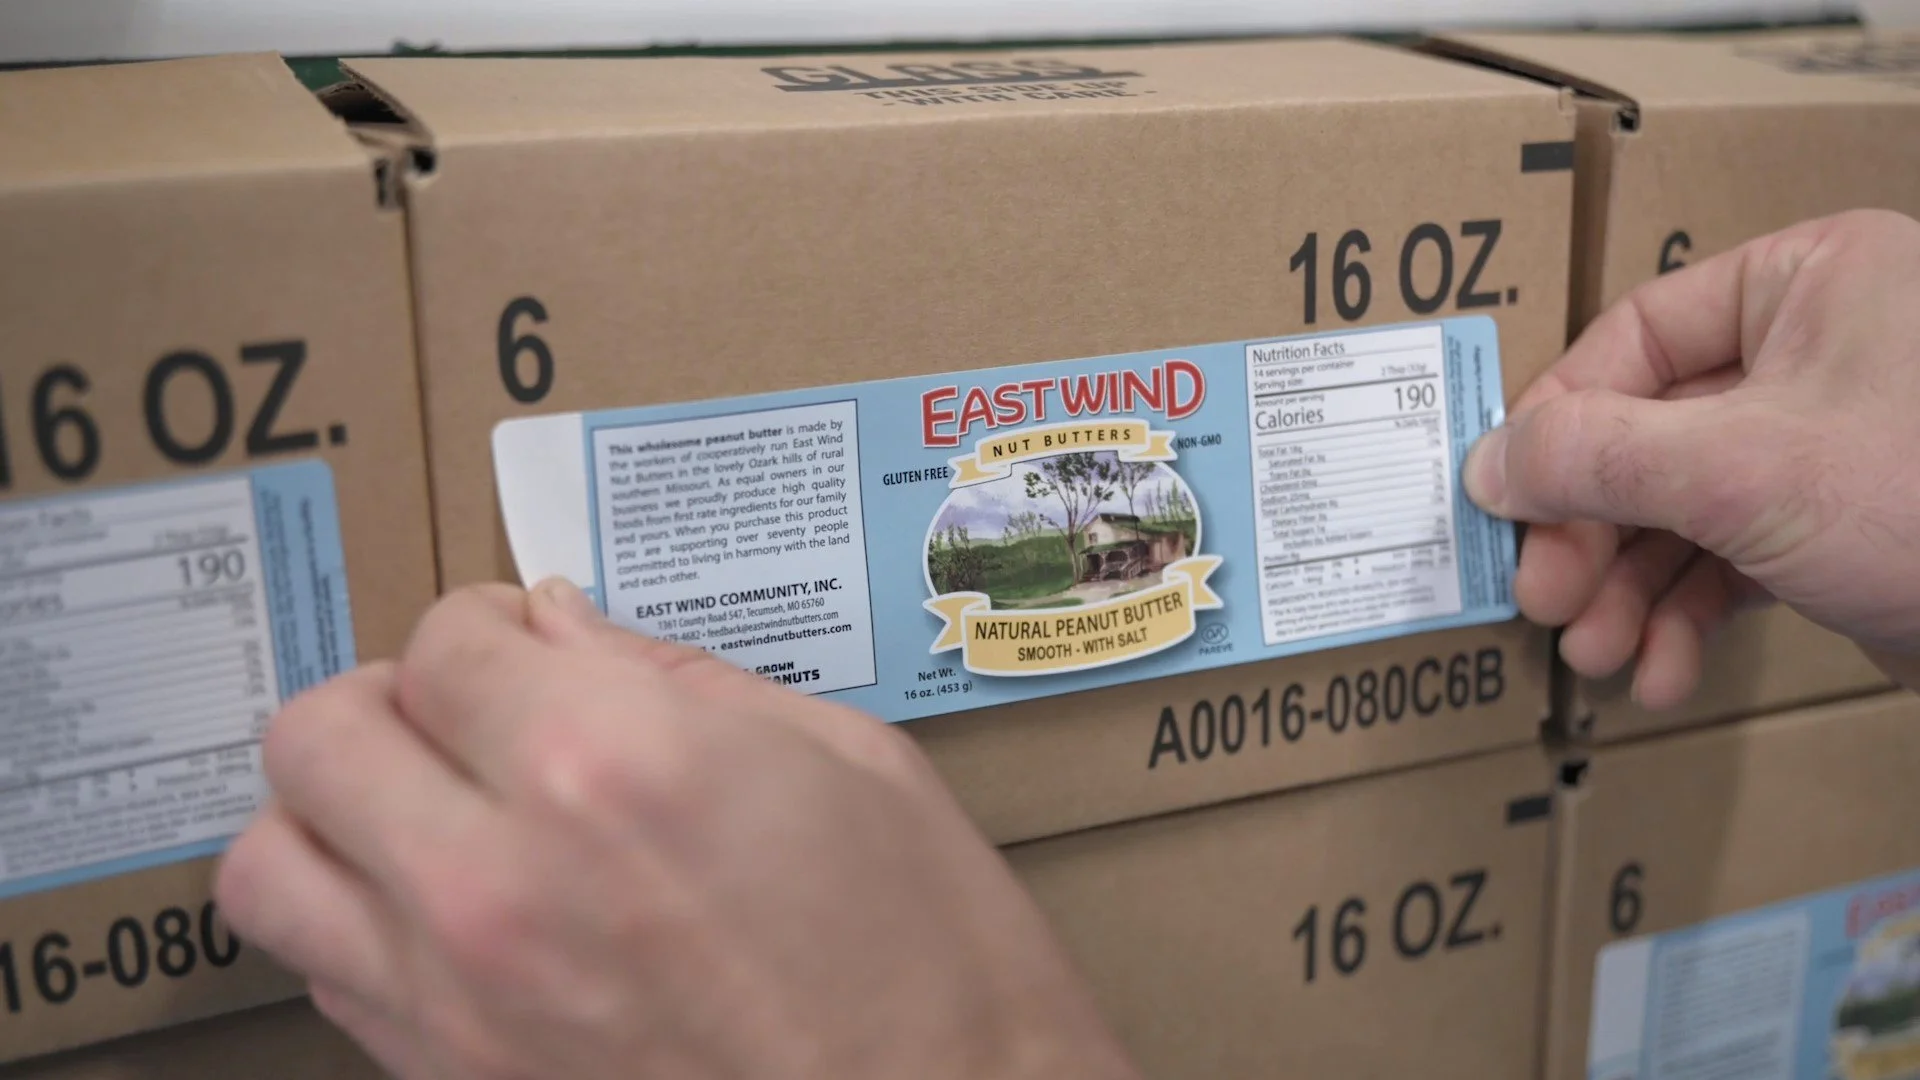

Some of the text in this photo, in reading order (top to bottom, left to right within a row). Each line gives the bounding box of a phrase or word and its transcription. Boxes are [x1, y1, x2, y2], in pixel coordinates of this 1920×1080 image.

[760, 60, 1103, 90] GLASS
[854, 81, 1127, 99] THIS SIDE UP
[897, 90, 1138, 105] WITH CARE
[1290, 220, 1518, 324] 16 OZ.
[498, 297, 554, 403] 6
[1253, 342, 1345, 363] Nutrition Facts
[1254, 361, 1354, 378] 14 servings per container
[1254, 380, 1286, 391] Serving
[143, 340, 346, 467] OZ.
[920, 359, 1206, 448] EAST WIND
[1255, 382, 1436, 430] Calories 190
[609, 419, 843, 456] This wholesome peanut butter is made by
[609, 433, 843, 471] the workers of cooperatively run East Wind
[992, 429, 1132, 457] NUT BUTTERS
[1177, 434, 1222, 450] NON-GMO
[636, 471, 673, 483] Butters
[678, 468, 688, 477] in
[692, 465, 710, 476] the
[714, 460, 744, 473] lovely
[749, 456, 778, 469] Ozark
[782, 453, 802, 464] hills
[806, 450, 817, 461] of
[821, 447, 844, 460] rural
[718, 477, 730, 487] As
[736, 471, 764, 486] equal
[770, 468, 807, 480] owners
[812, 464, 822, 475] in
[827, 463, 845, 474] our
[883, 467, 948, 486] GLUTEN FREE
[664, 500, 681, 509] we
[686, 491, 728, 509] proudly
[734, 486, 776, 502] produce
[782, 482, 805, 495] high
[811, 477, 846, 491] quality
[673, 511, 694, 522] first
[696, 509, 717, 519] rate
[719, 501, 777, 518] ingredients
[780, 498, 794, 508] for
[796, 496, 814, 506] our
[816, 491, 847, 503] family
[614, 532, 635, 545] and
[675, 525, 706, 537] When
[709, 522, 730, 535] you
[734, 515, 781, 531] purchase
[785, 511, 804, 522] this
[808, 506, 848, 521] product
[615, 519, 849, 562] you are supporting over seventy people
[177, 549, 245, 588] 190
[617, 533, 850, 575] committed to living in harmony with the land
[619, 571, 700, 590] and each other.
[636, 578, 842, 619] EAST WIND COMMUNITY, INC.
[680, 616, 706, 628] County
[708, 611, 727, 623] Road
[728, 609, 746, 620] 547,
[747, 603, 785, 618] Tecumseh,
[787, 600, 800, 611] MO
[801, 597, 825, 609] 65760
[707, 610, 839, 638] feedback@eastwindnutbutters.com
[975, 592, 1184, 640] NATURAL PEANUT BUTTER
[721, 623, 852, 650] eastwindnutbutters.com
[1018, 646, 1072, 662] SMOOTH
[1083, 639, 1115, 656] WITH
[1118, 628, 1148, 649] SALT
[1199, 643, 1233, 656] PAREVE
[755, 661, 794, 675] GROWN
[764, 669, 820, 686] ANUTS
[918, 666, 956, 682] Net Wt.
[904, 679, 973, 701] 16 oz. (453 g)
[1148, 647, 1504, 769] A0016-080C6B
[1610, 861, 1645, 933] 6
[1293, 869, 1503, 985] 16 OZ.
